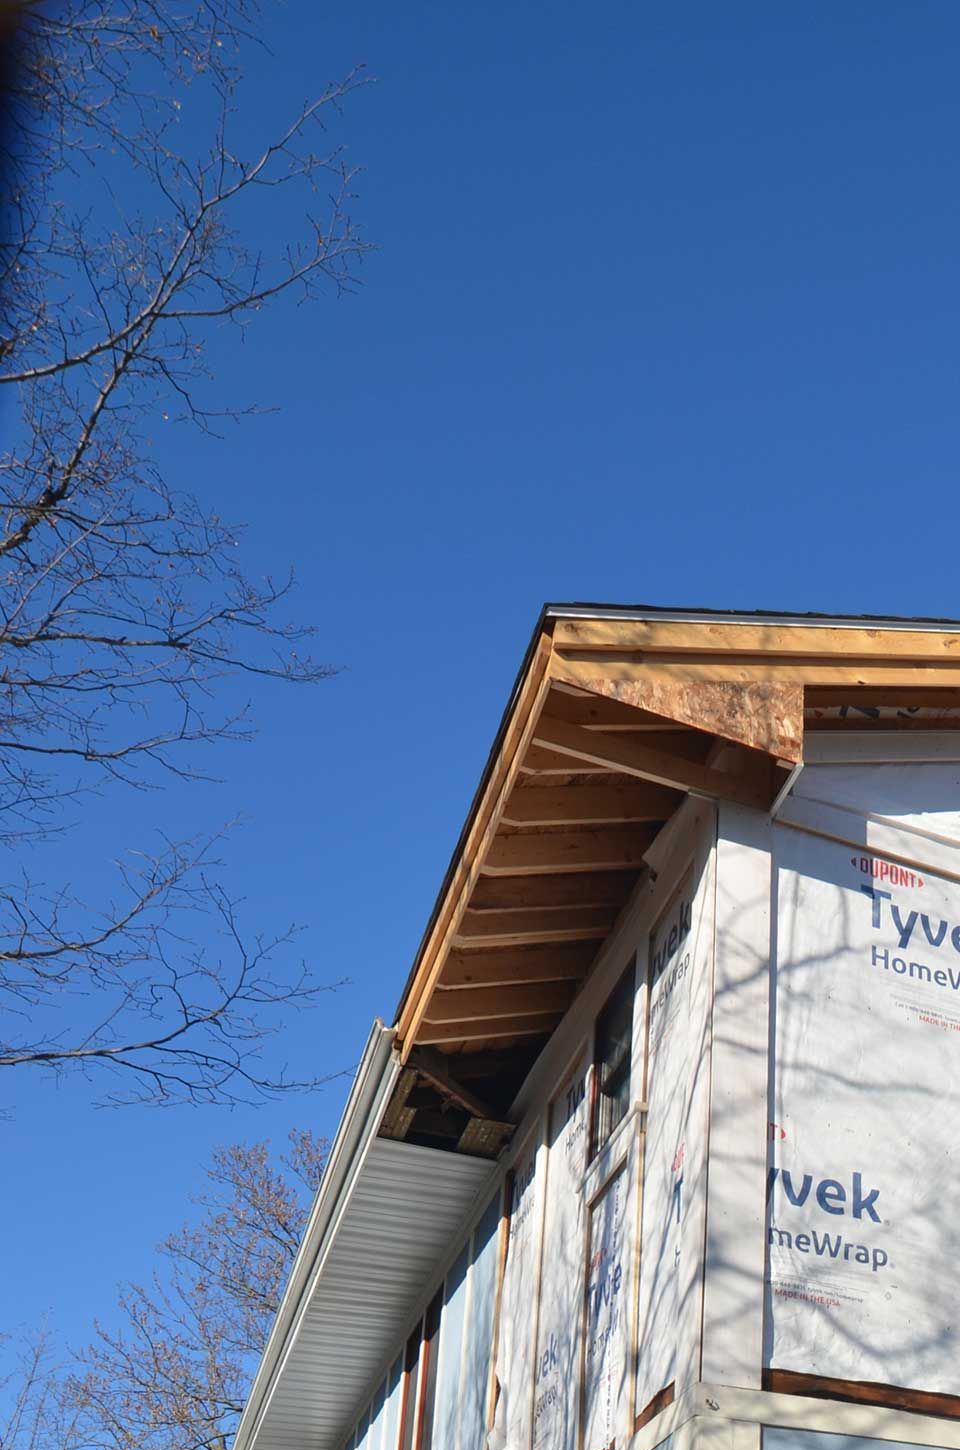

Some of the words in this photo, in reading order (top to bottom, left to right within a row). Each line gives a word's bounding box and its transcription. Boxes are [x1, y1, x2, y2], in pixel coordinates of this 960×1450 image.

[860, 857, 916, 888] DUPONT
[775, 1288, 797, 1300] MADE
[808, 1294, 825, 1305] THE
[826, 1297, 841, 1307] USA
